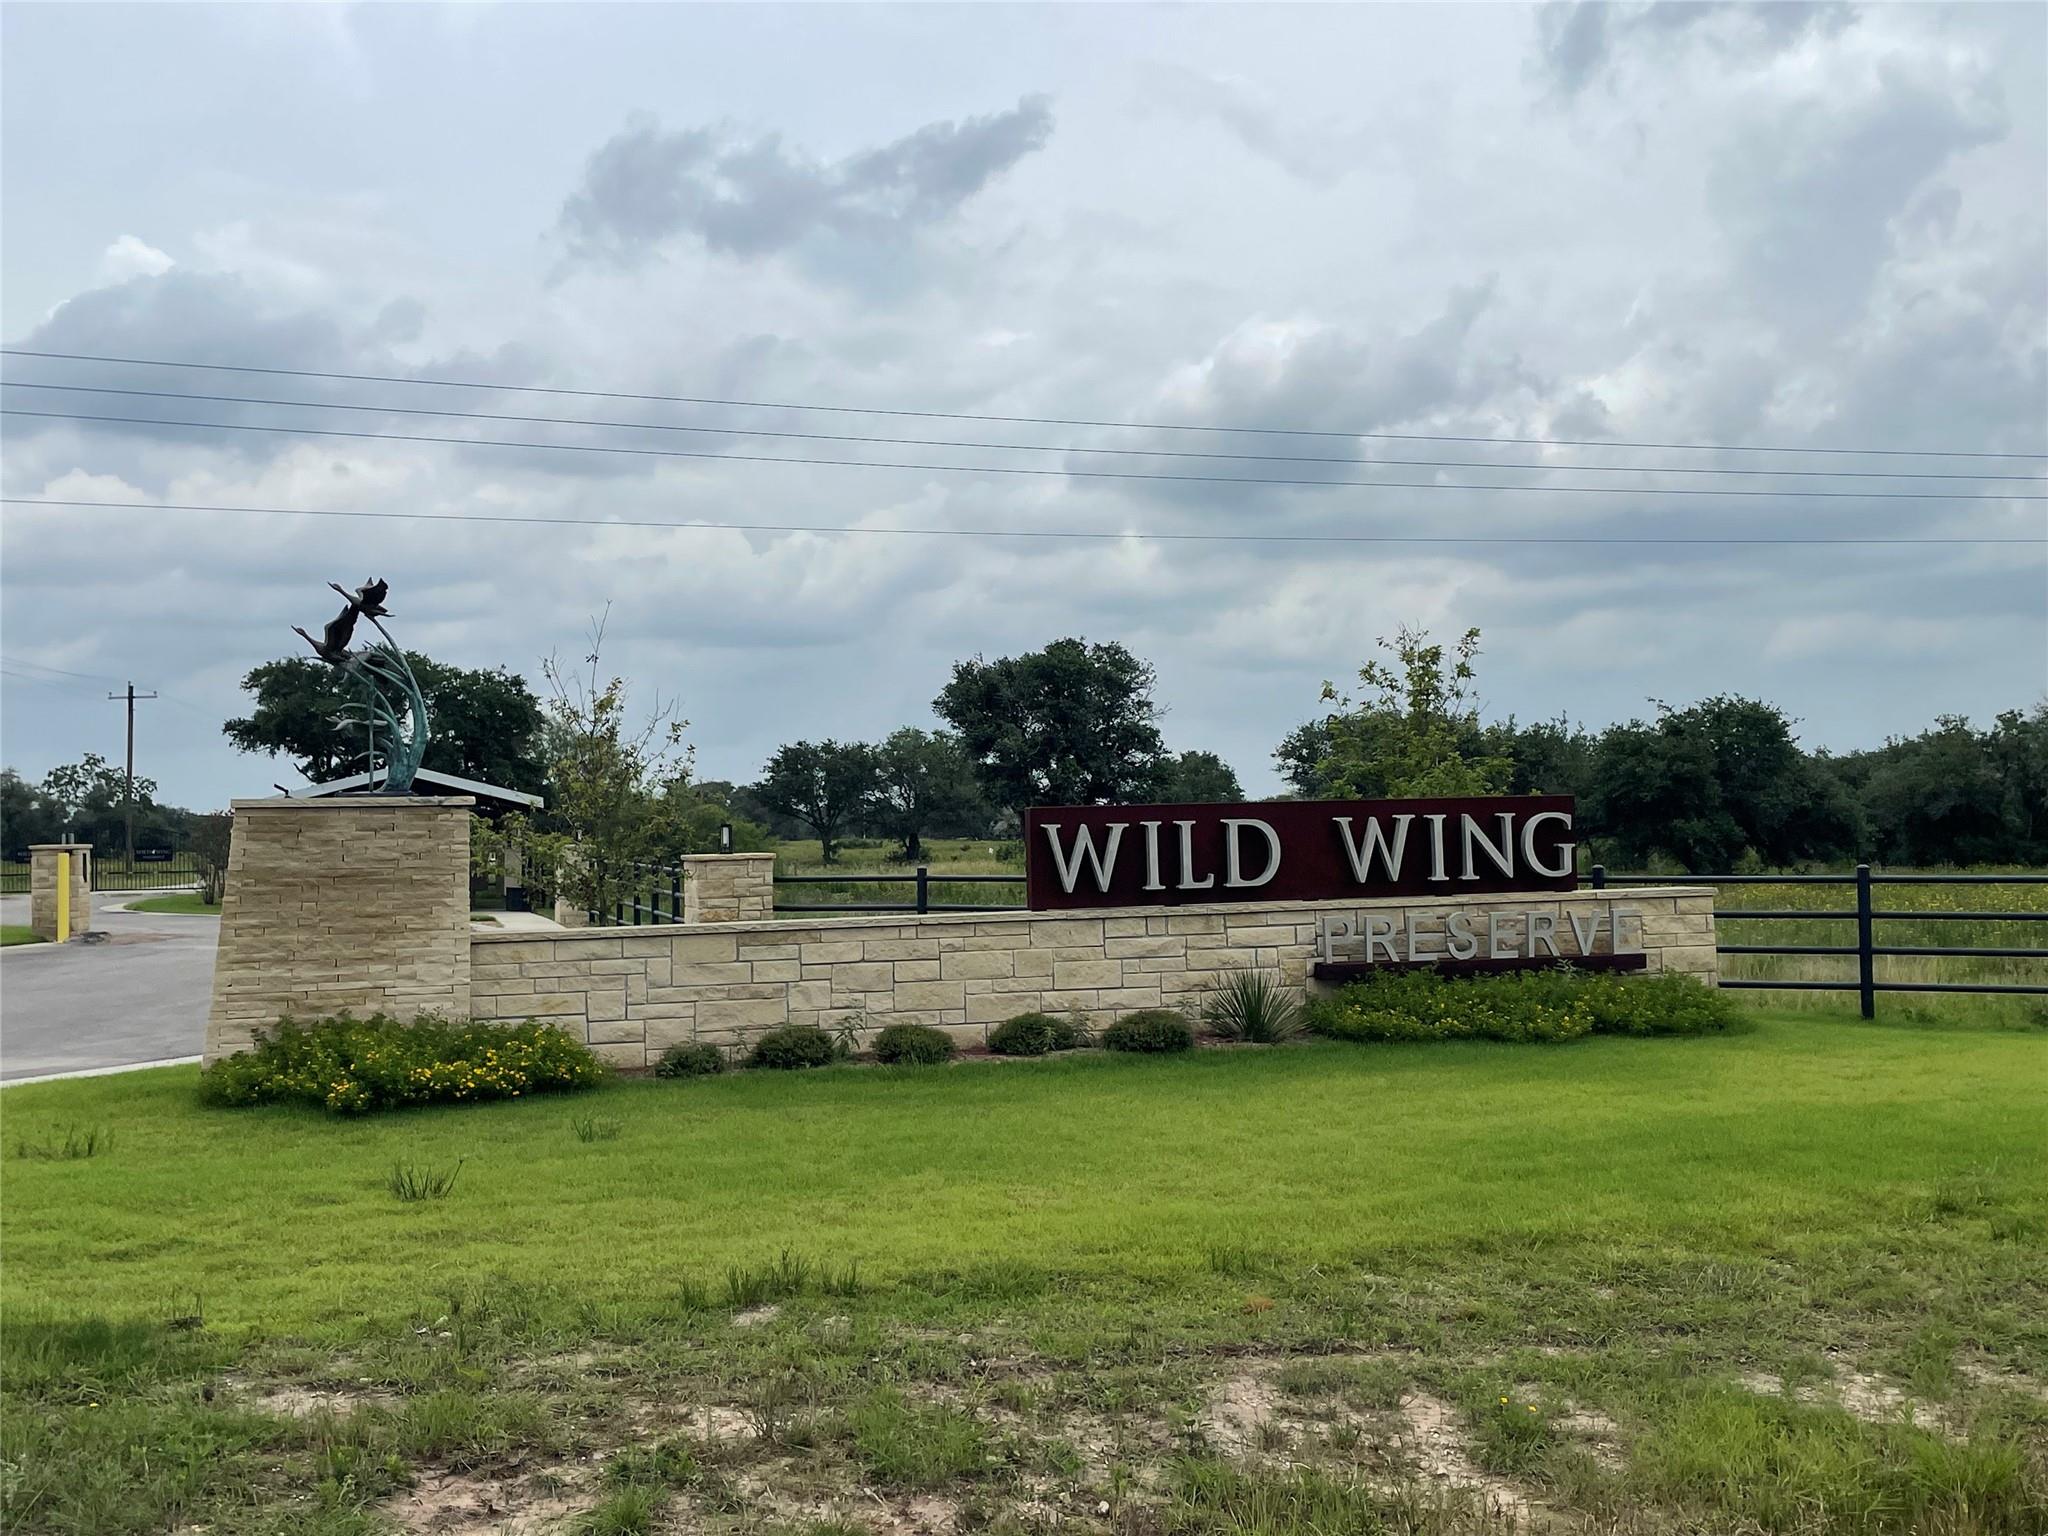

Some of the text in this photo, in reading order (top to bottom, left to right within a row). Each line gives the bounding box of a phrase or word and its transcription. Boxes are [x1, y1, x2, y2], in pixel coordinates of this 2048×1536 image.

[1040, 812, 1576, 893] WILD WING
[1321, 908, 1642, 964] PRESERVE
